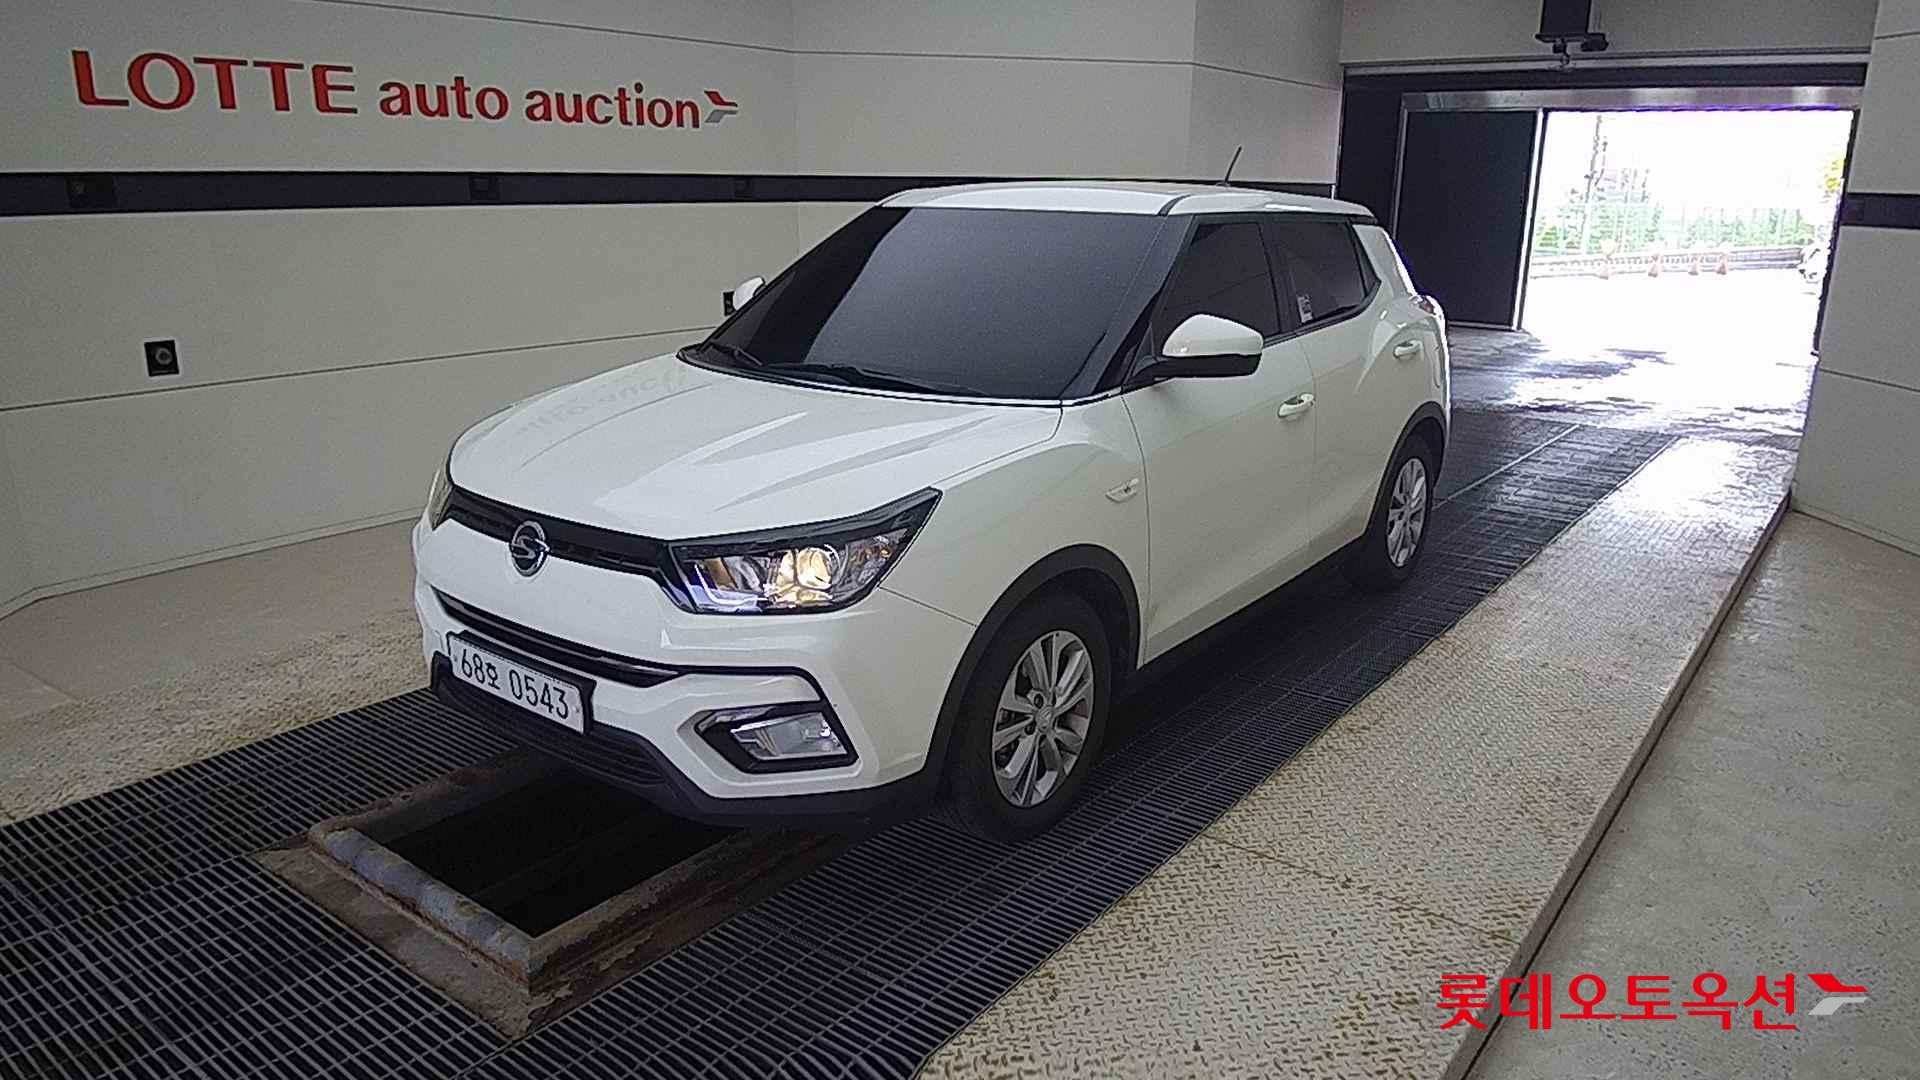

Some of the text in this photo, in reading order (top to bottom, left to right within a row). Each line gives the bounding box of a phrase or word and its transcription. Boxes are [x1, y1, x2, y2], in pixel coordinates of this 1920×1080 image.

[71, 49, 701, 129] LOTTE auto auction
[461, 648, 569, 720] 68호 0543
